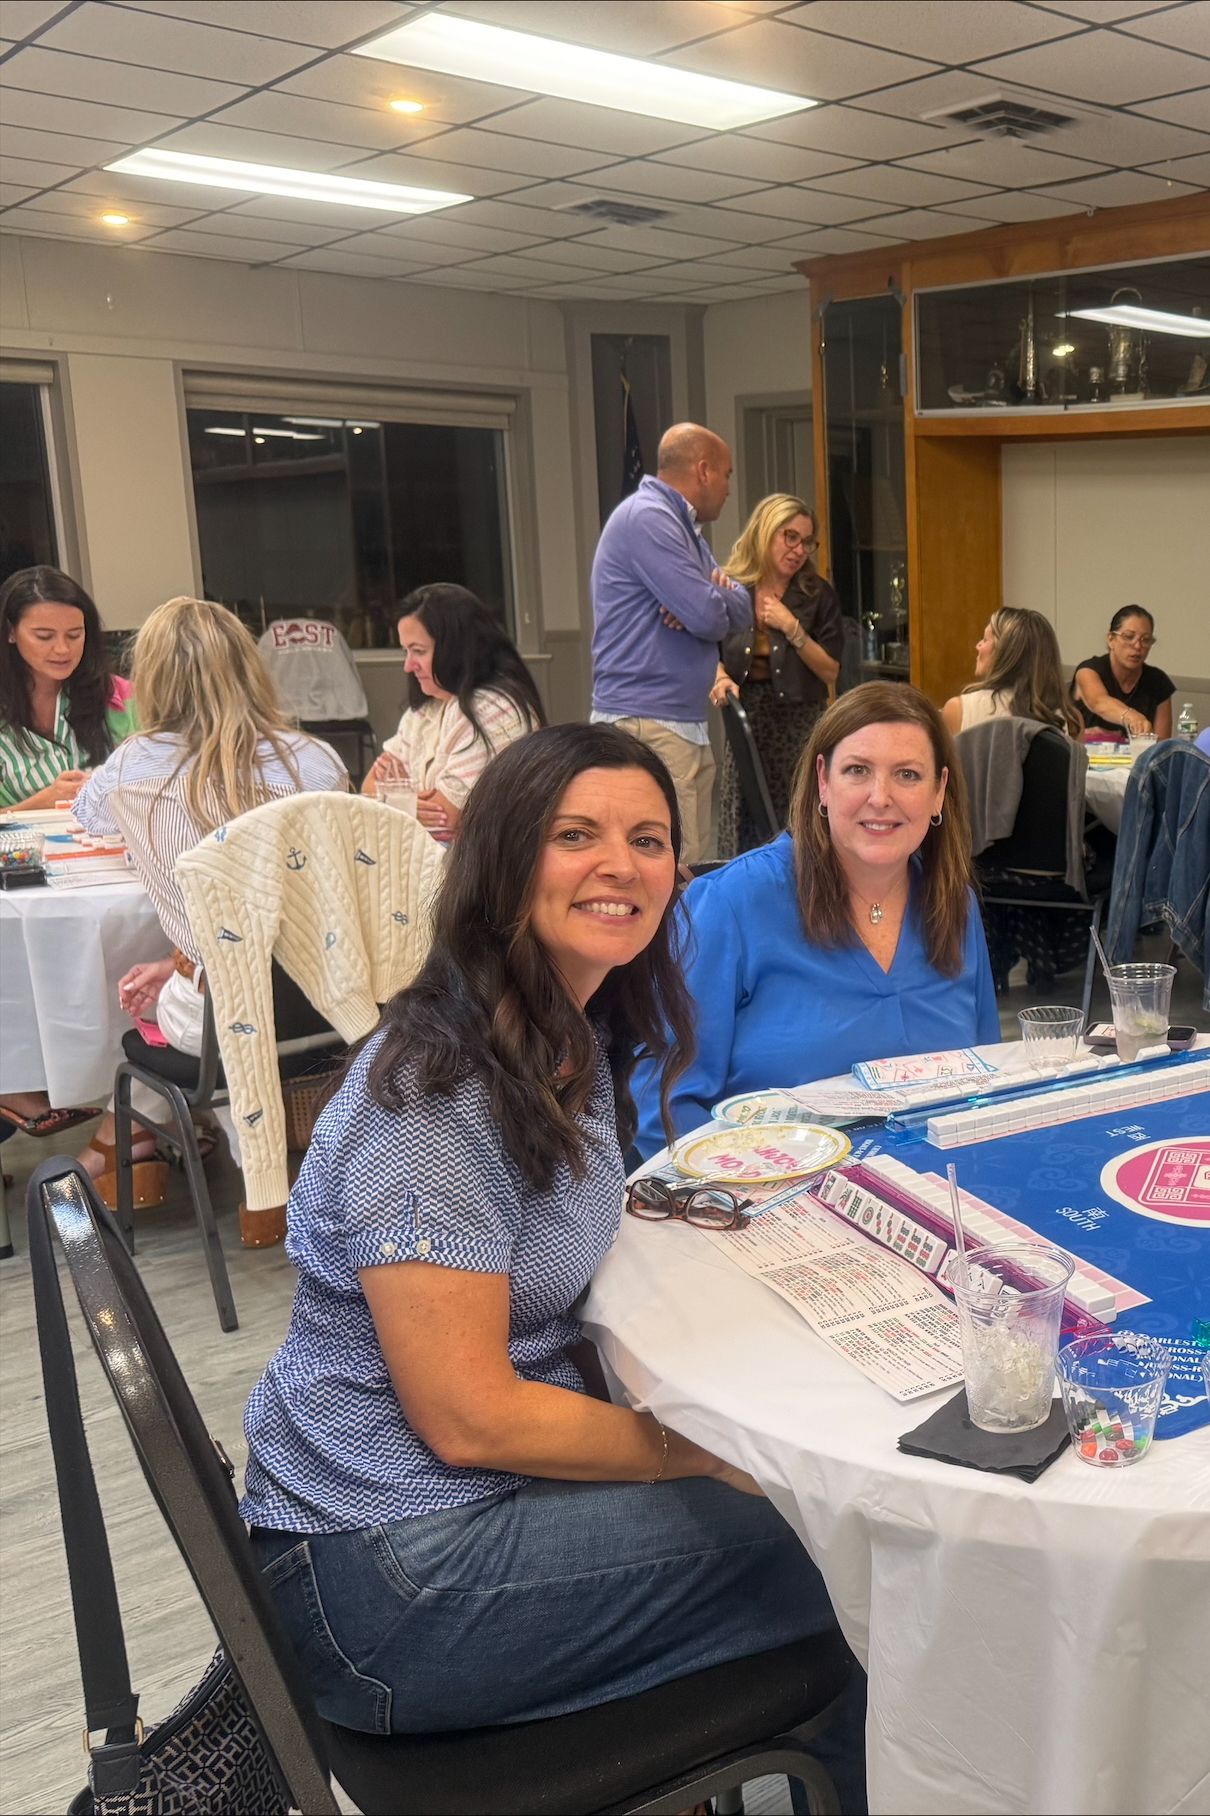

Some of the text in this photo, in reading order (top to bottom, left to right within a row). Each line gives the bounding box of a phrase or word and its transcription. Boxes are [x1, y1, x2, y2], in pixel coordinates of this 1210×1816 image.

[1105, 1124, 1146, 1138] WEST
[1055, 1206, 1101, 1232] SOUTH
[1081, 1206, 1110, 1221] 南
